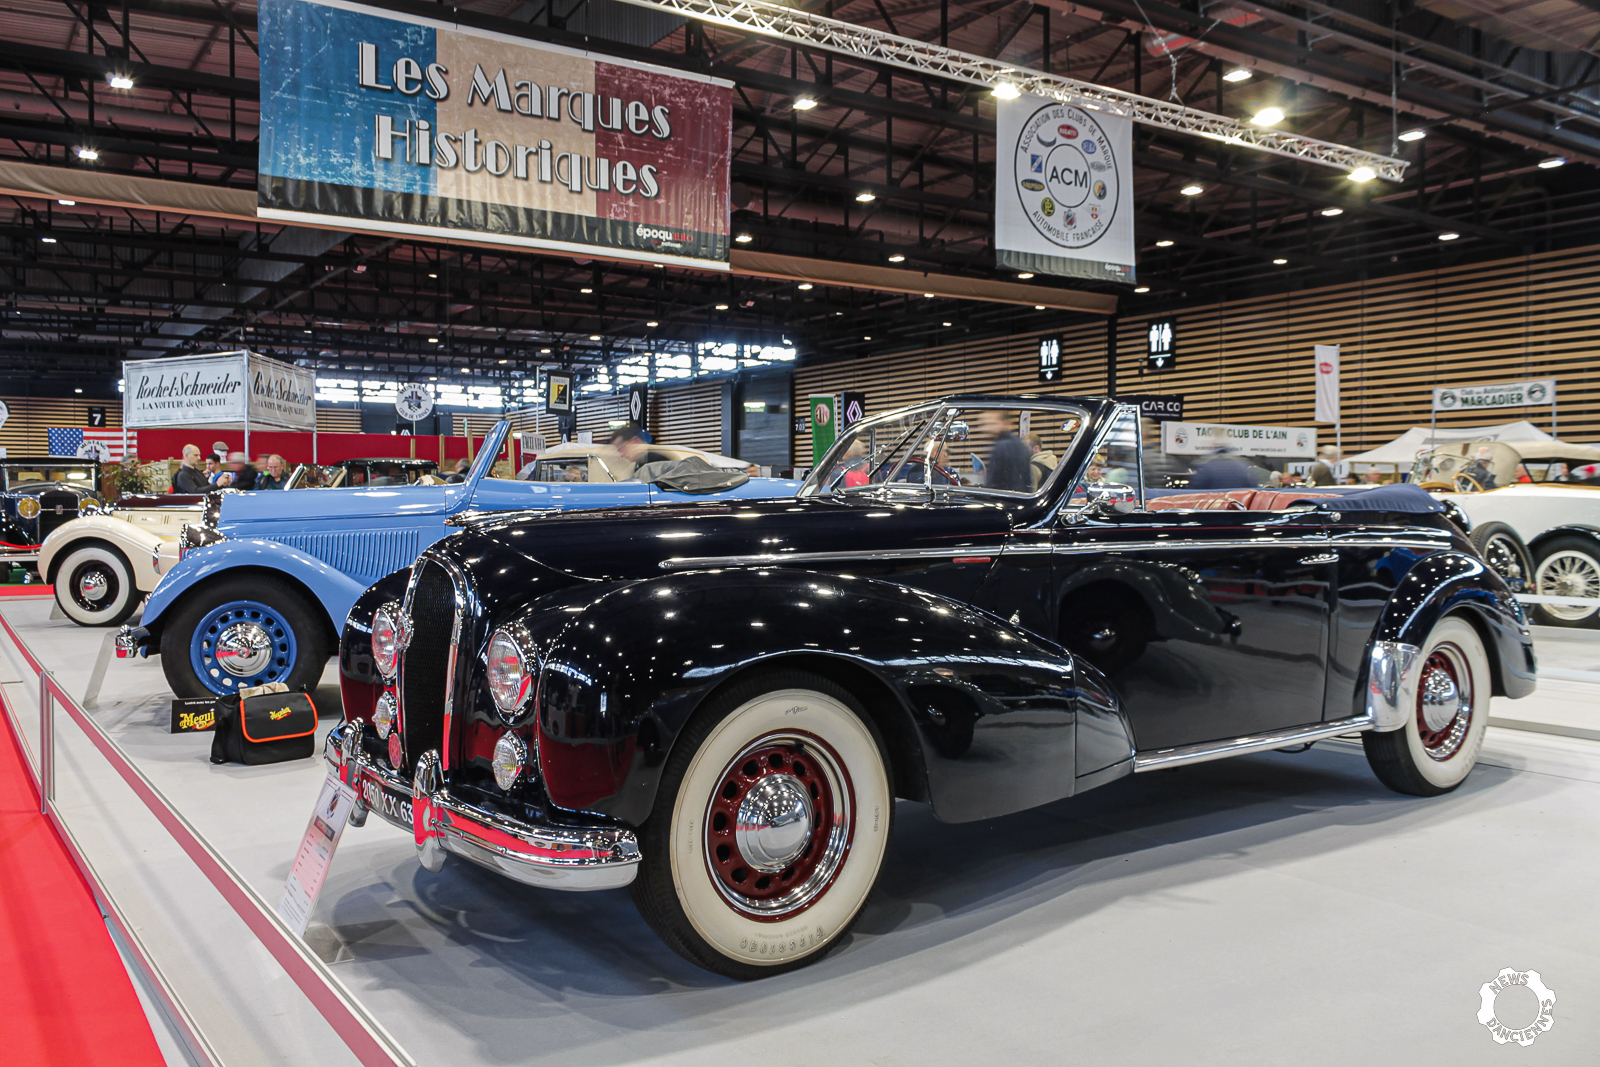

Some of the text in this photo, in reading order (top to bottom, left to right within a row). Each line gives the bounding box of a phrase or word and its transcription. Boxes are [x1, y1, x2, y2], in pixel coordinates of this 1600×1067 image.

[359, 41, 671, 139] Les Marques
[1020, 111, 1051, 154] ASSOCIATION
[1052, 109, 1065, 119] DES
[1067, 108, 1087, 127] CLUBS
[1088, 125, 1097, 136] DE
[1096, 136, 1113, 170] MARQUE
[375, 113, 660, 199] Historiques
[1049, 165, 1088, 189] ACM
[1032, 210, 1069, 242] AUTOMOBILE
[154, 400, 185, 410] VOITURE
[1142, 401, 1181, 412] CAR CO
[1460, 393, 1524, 407] MARCADIER
[92, 413, 101, 426] 7
[1227, 429, 1249, 439] CLUB
[1252, 430, 1263, 439] DE
[1265, 430, 1288, 440] L'AIN
[362, 779, 379, 808] 2050
[381, 791, 399, 818] XX
